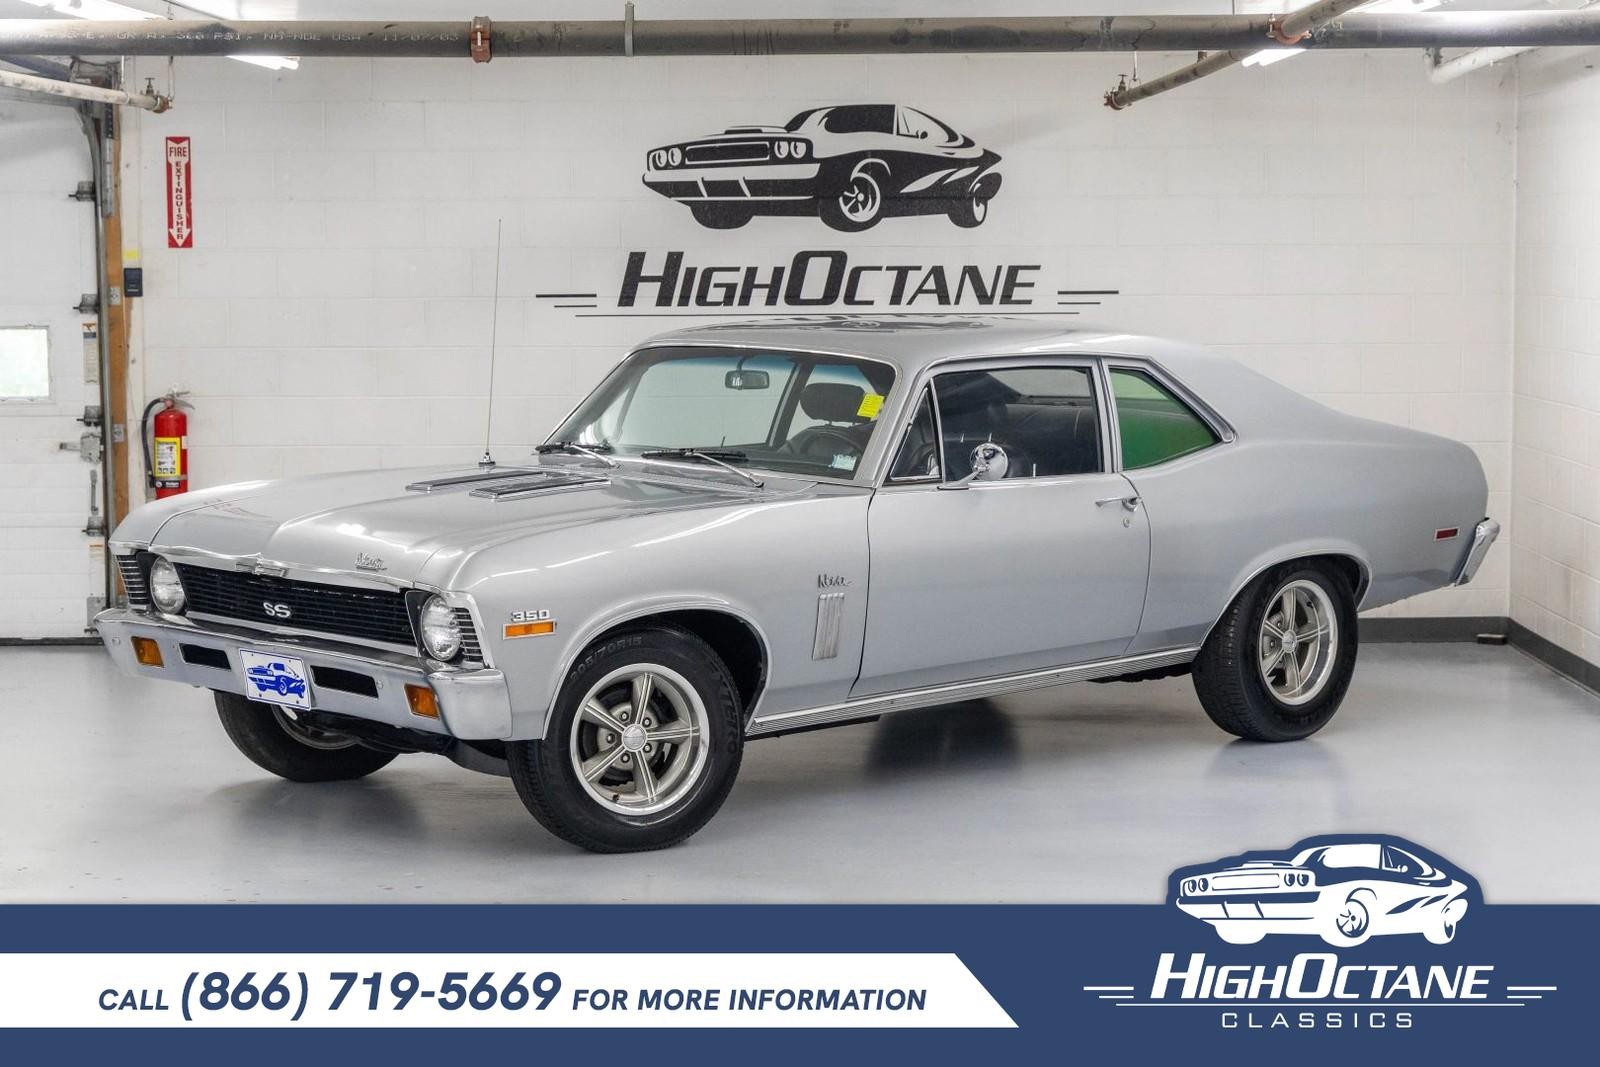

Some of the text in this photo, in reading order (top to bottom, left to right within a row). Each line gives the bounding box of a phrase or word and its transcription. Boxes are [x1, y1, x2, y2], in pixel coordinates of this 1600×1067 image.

[169, 146, 187, 158] FIRE
[175, 161, 184, 240] EXTINGUISHER
[262, 602, 292, 618] SS
[511, 609, 550, 622] 350
